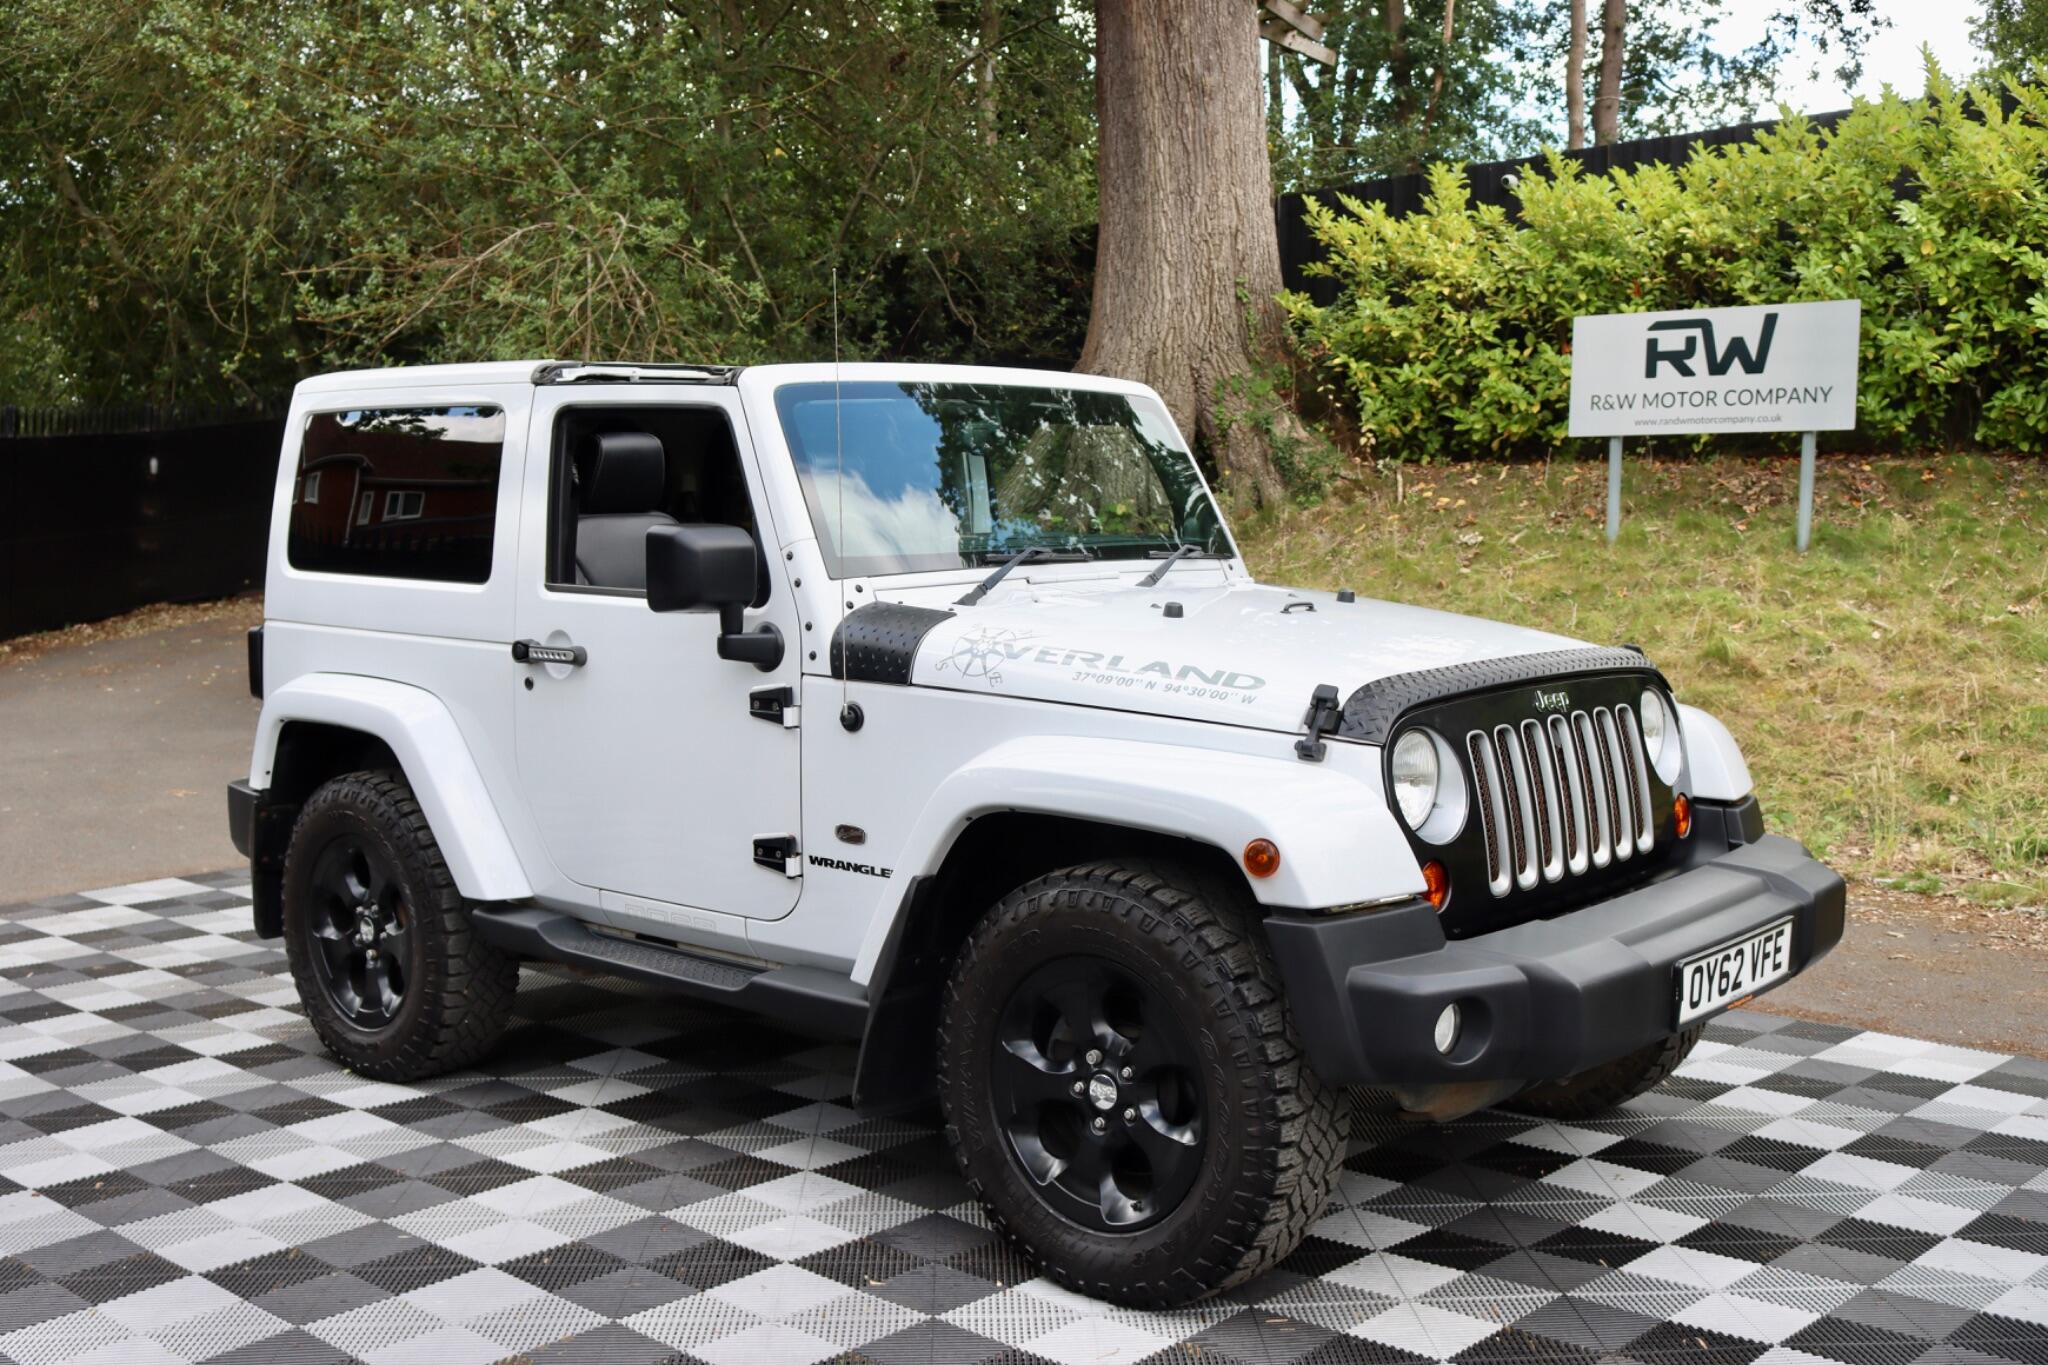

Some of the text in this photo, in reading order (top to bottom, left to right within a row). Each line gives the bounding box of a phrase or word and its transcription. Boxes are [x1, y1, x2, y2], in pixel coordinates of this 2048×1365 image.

[1645, 313, 1779, 379] RW
[1590, 385, 1834, 411] R&W MOTOR COMPANY
[1634, 413, 1783, 427] www.randwmotorcompany.co.uk
[1144, 681, 1158, 691] N
[1241, 693, 1258, 705] W
[1534, 689, 1570, 713] Jeep
[808, 854, 894, 879] WRANGLE
[1689, 928, 1785, 1010] OY62 VFE
